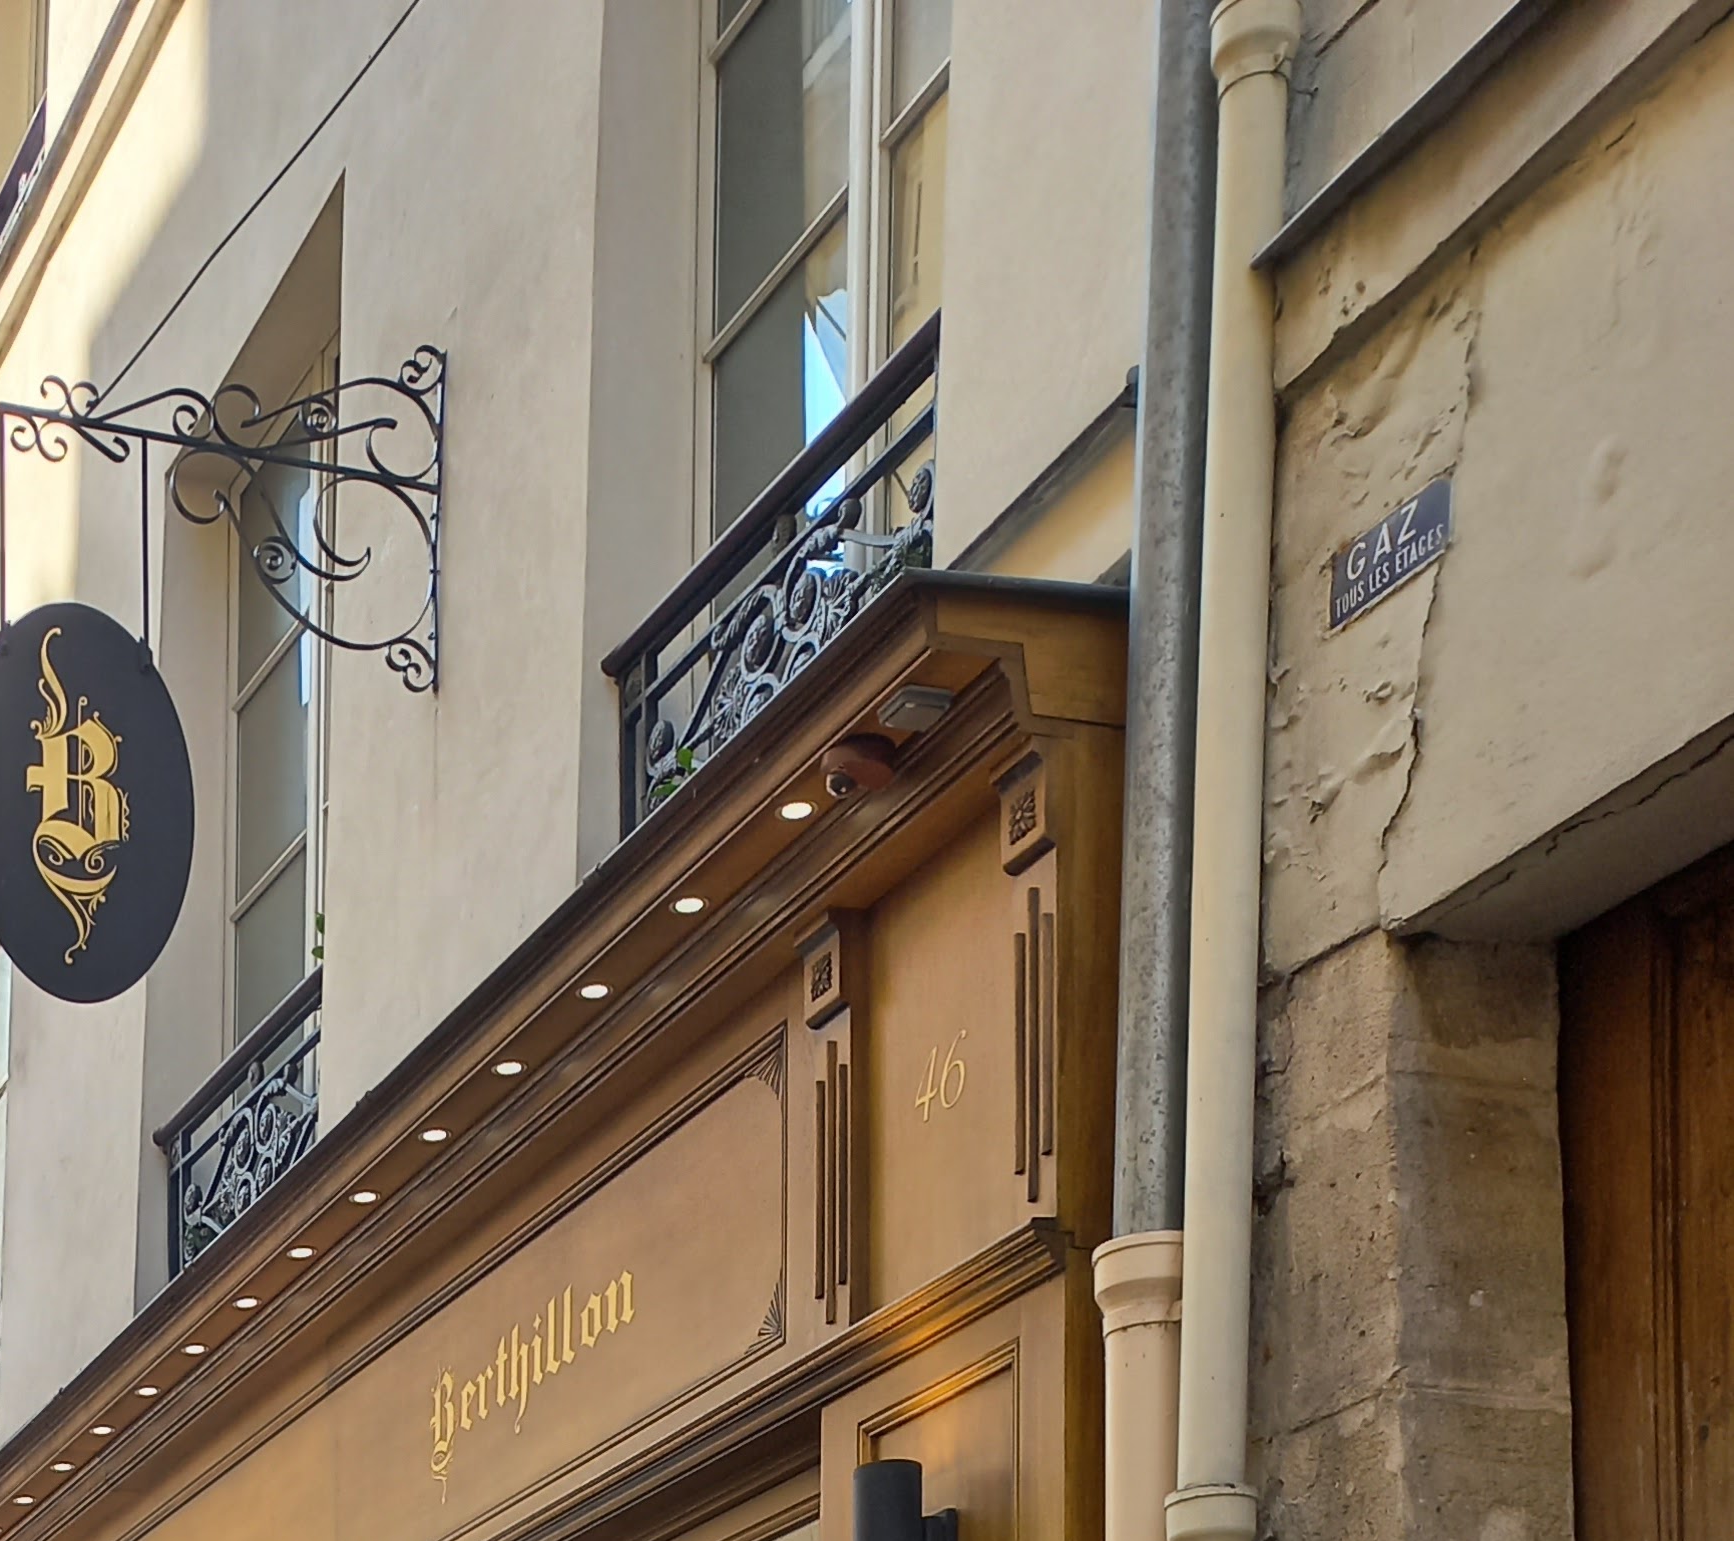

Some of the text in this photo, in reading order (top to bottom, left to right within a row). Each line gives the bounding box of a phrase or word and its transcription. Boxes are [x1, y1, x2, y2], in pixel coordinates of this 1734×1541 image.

[1346, 498, 1418, 581] GAZ
[1334, 580, 1365, 619] TOUS
[1368, 561, 1390, 594] LES
[26, 628, 129, 965] B
[914, 1028, 967, 1122] 46
[429, 1269, 636, 1504] Berthillon
